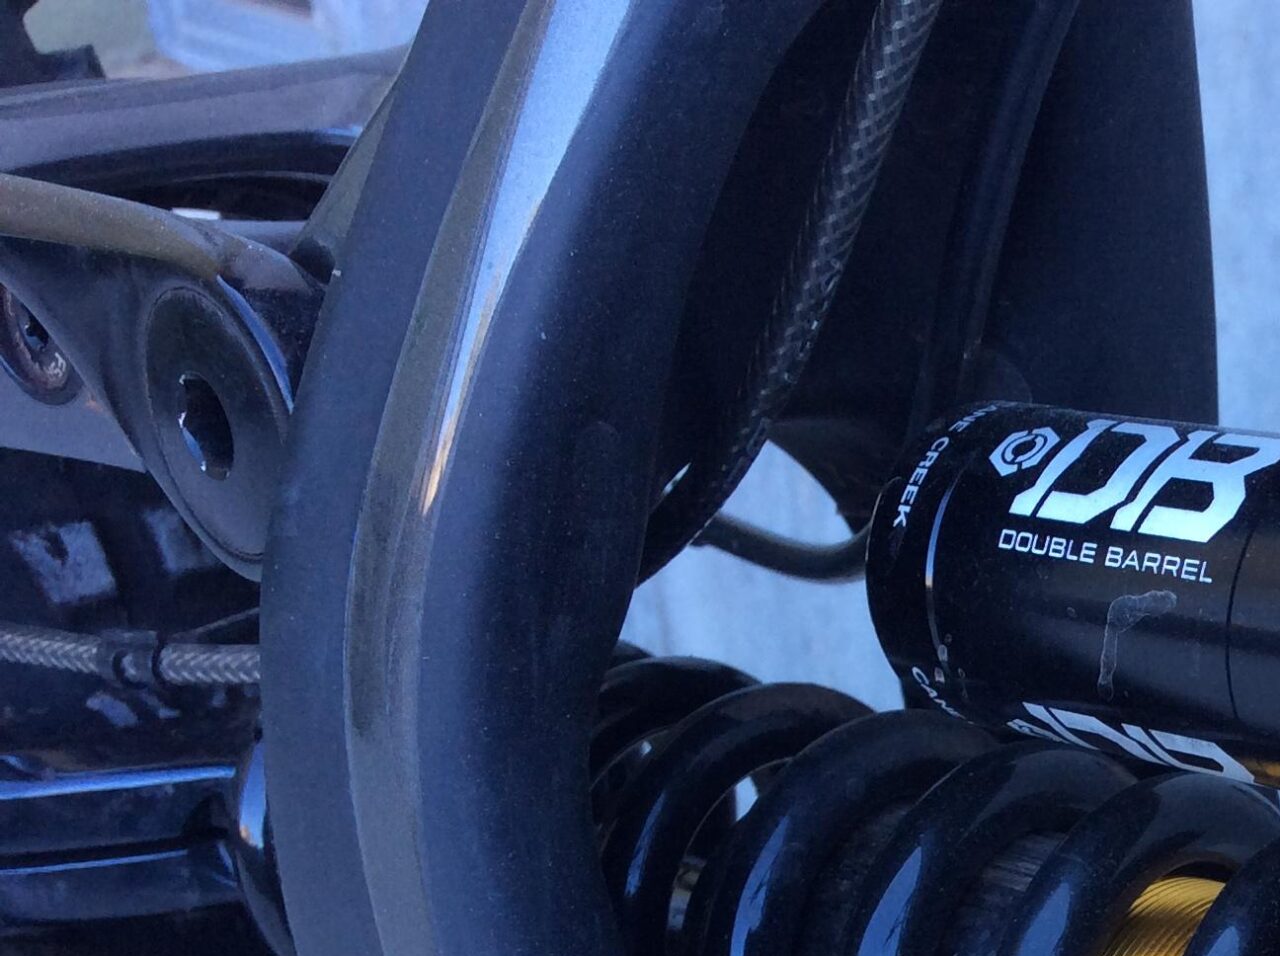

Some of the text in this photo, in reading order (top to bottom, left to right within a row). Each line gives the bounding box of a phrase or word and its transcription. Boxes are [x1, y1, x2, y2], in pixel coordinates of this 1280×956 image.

[893, 436, 950, 527] CREEK
[998, 529, 1213, 584] DOUBLE BARREL
